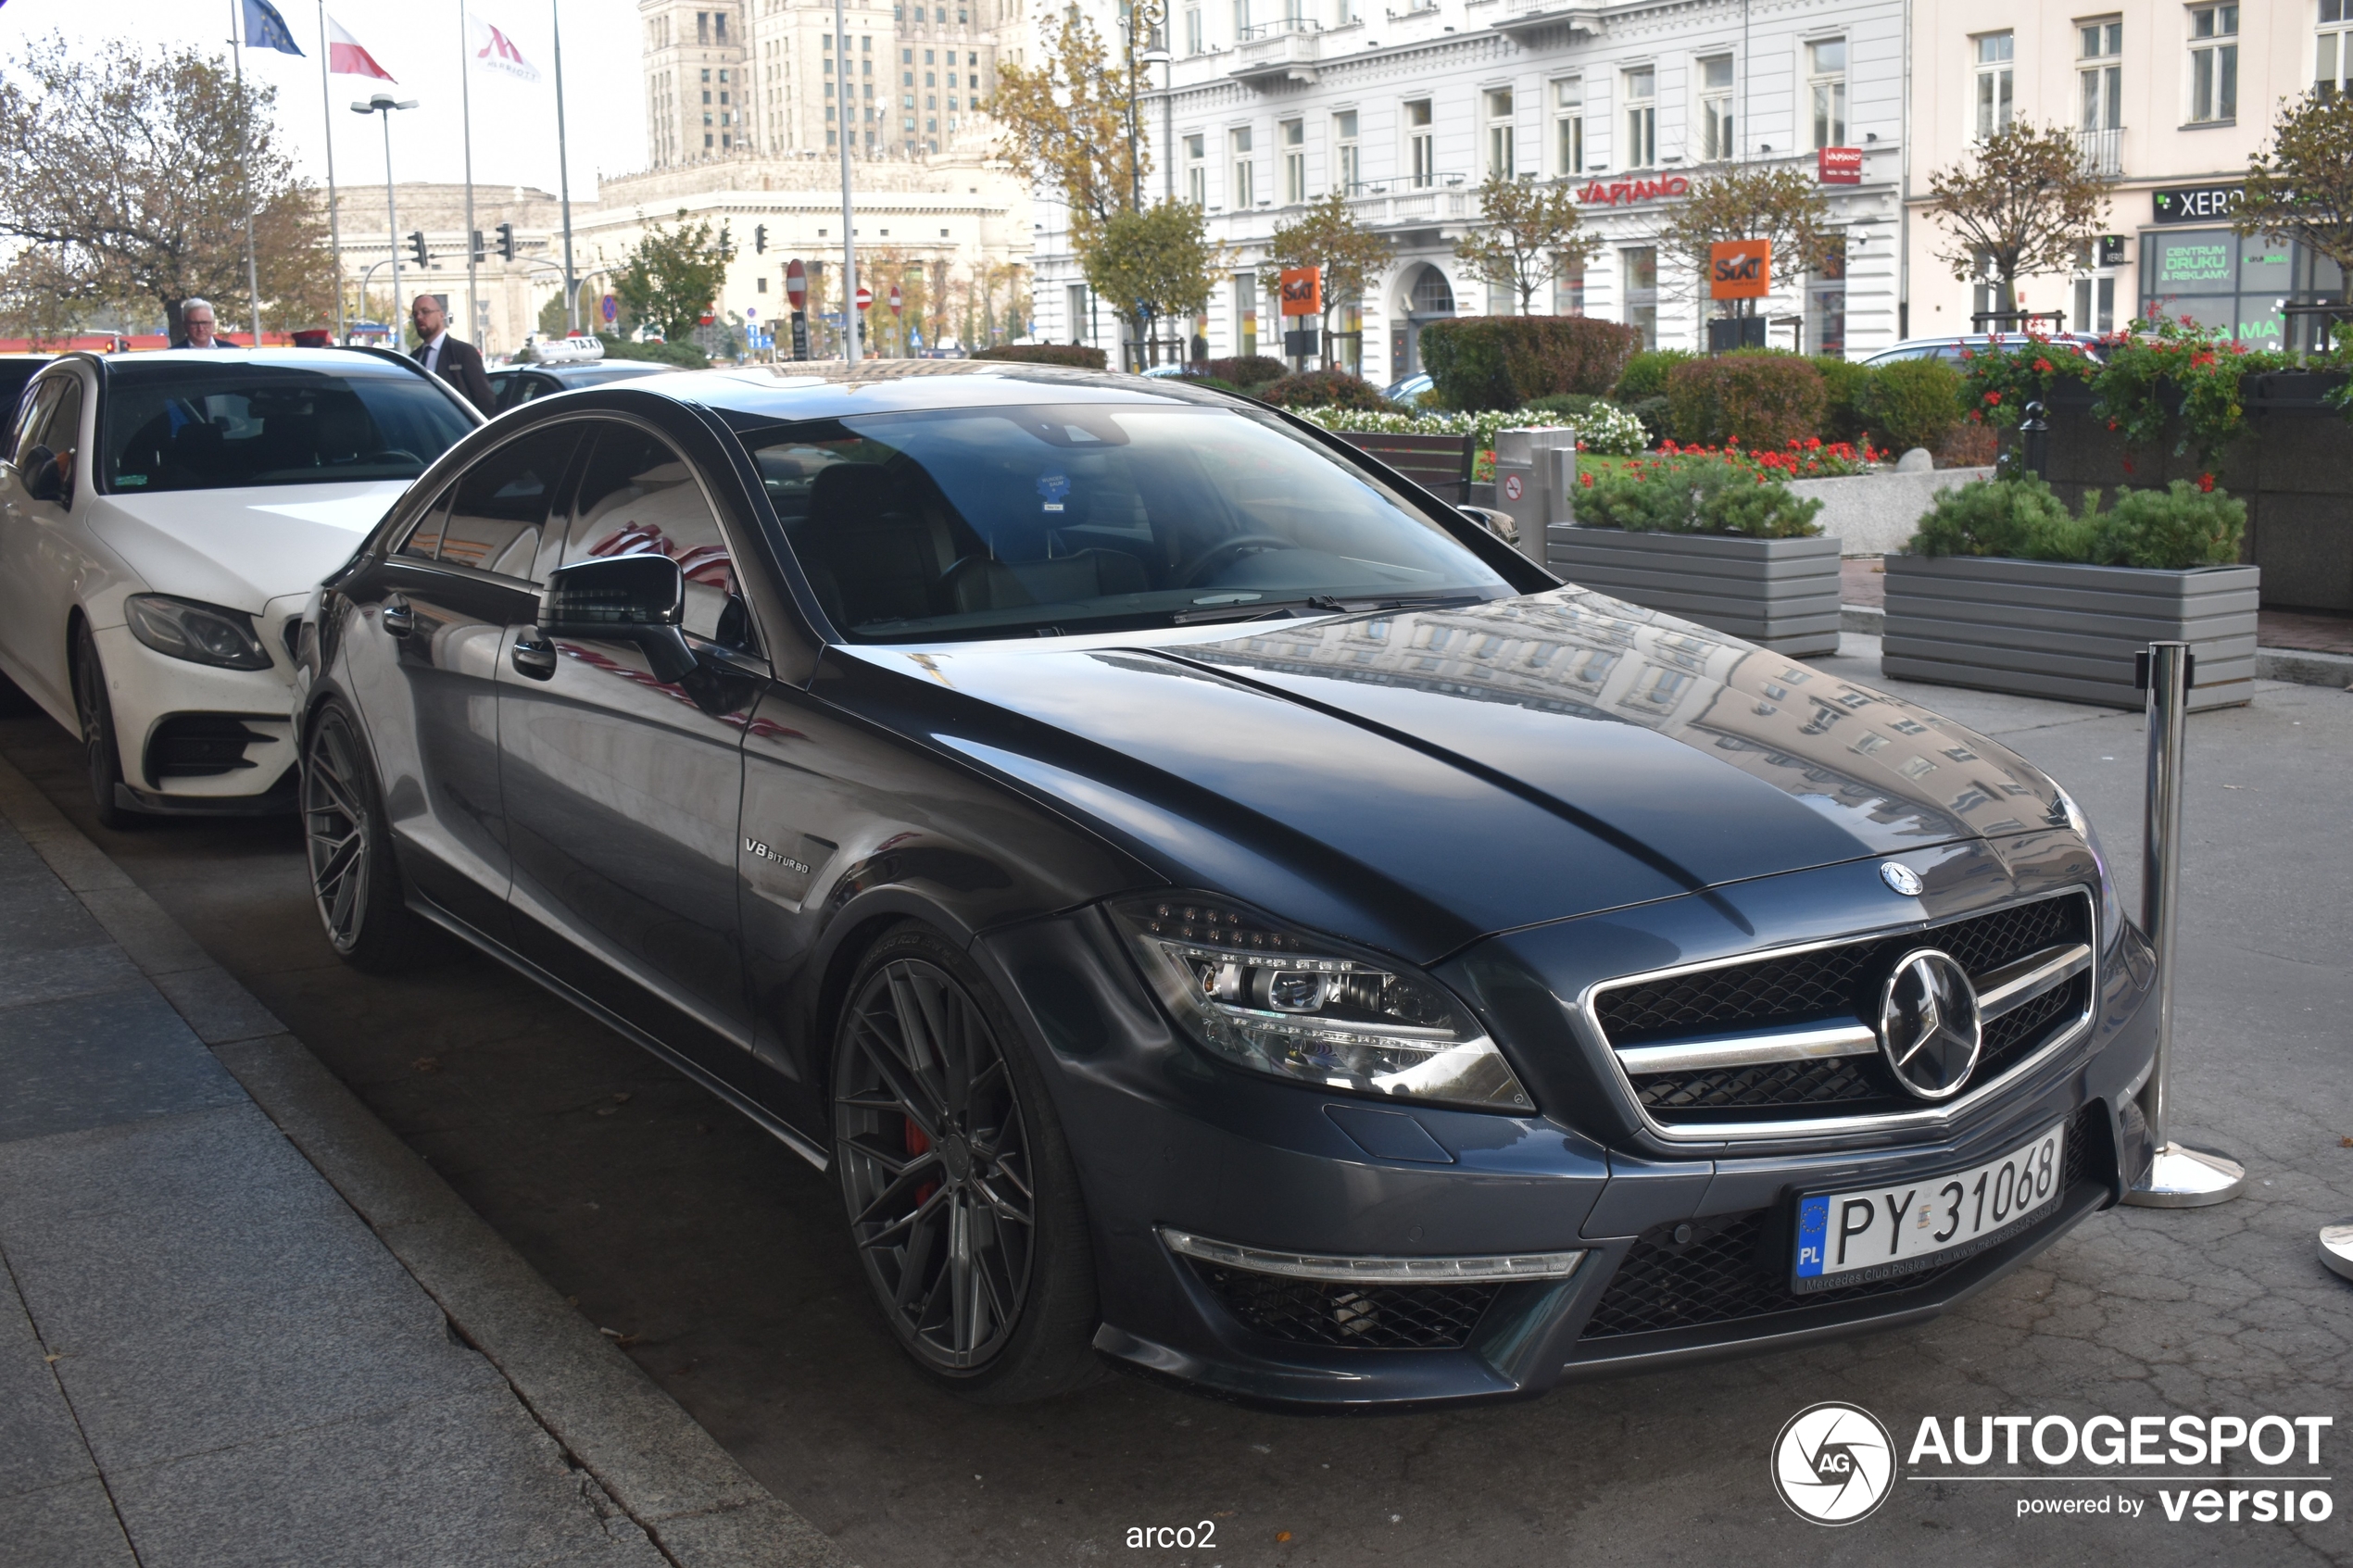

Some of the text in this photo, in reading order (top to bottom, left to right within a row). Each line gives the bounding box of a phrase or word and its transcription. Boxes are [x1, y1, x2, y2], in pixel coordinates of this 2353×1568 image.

[1577, 172, 1688, 207] VAPIANO
[2106, 252, 2123, 262] XERO
[2166, 245, 2226, 257] CENTRUM
[2165, 256, 2226, 270] DRUKU
[2161, 270, 2230, 281] & REKLAMY
[570, 338, 601, 350] TAXI
[746, 837, 810, 874] V8 BITURBO
[1837, 1137, 2055, 1265] PY 31068
[1799, 1246, 1820, 1265] PL
[1806, 1272, 1861, 1291] Mercedes
[1864, 1268, 1889, 1282] Club
[1891, 1260, 1926, 1275] Polska
